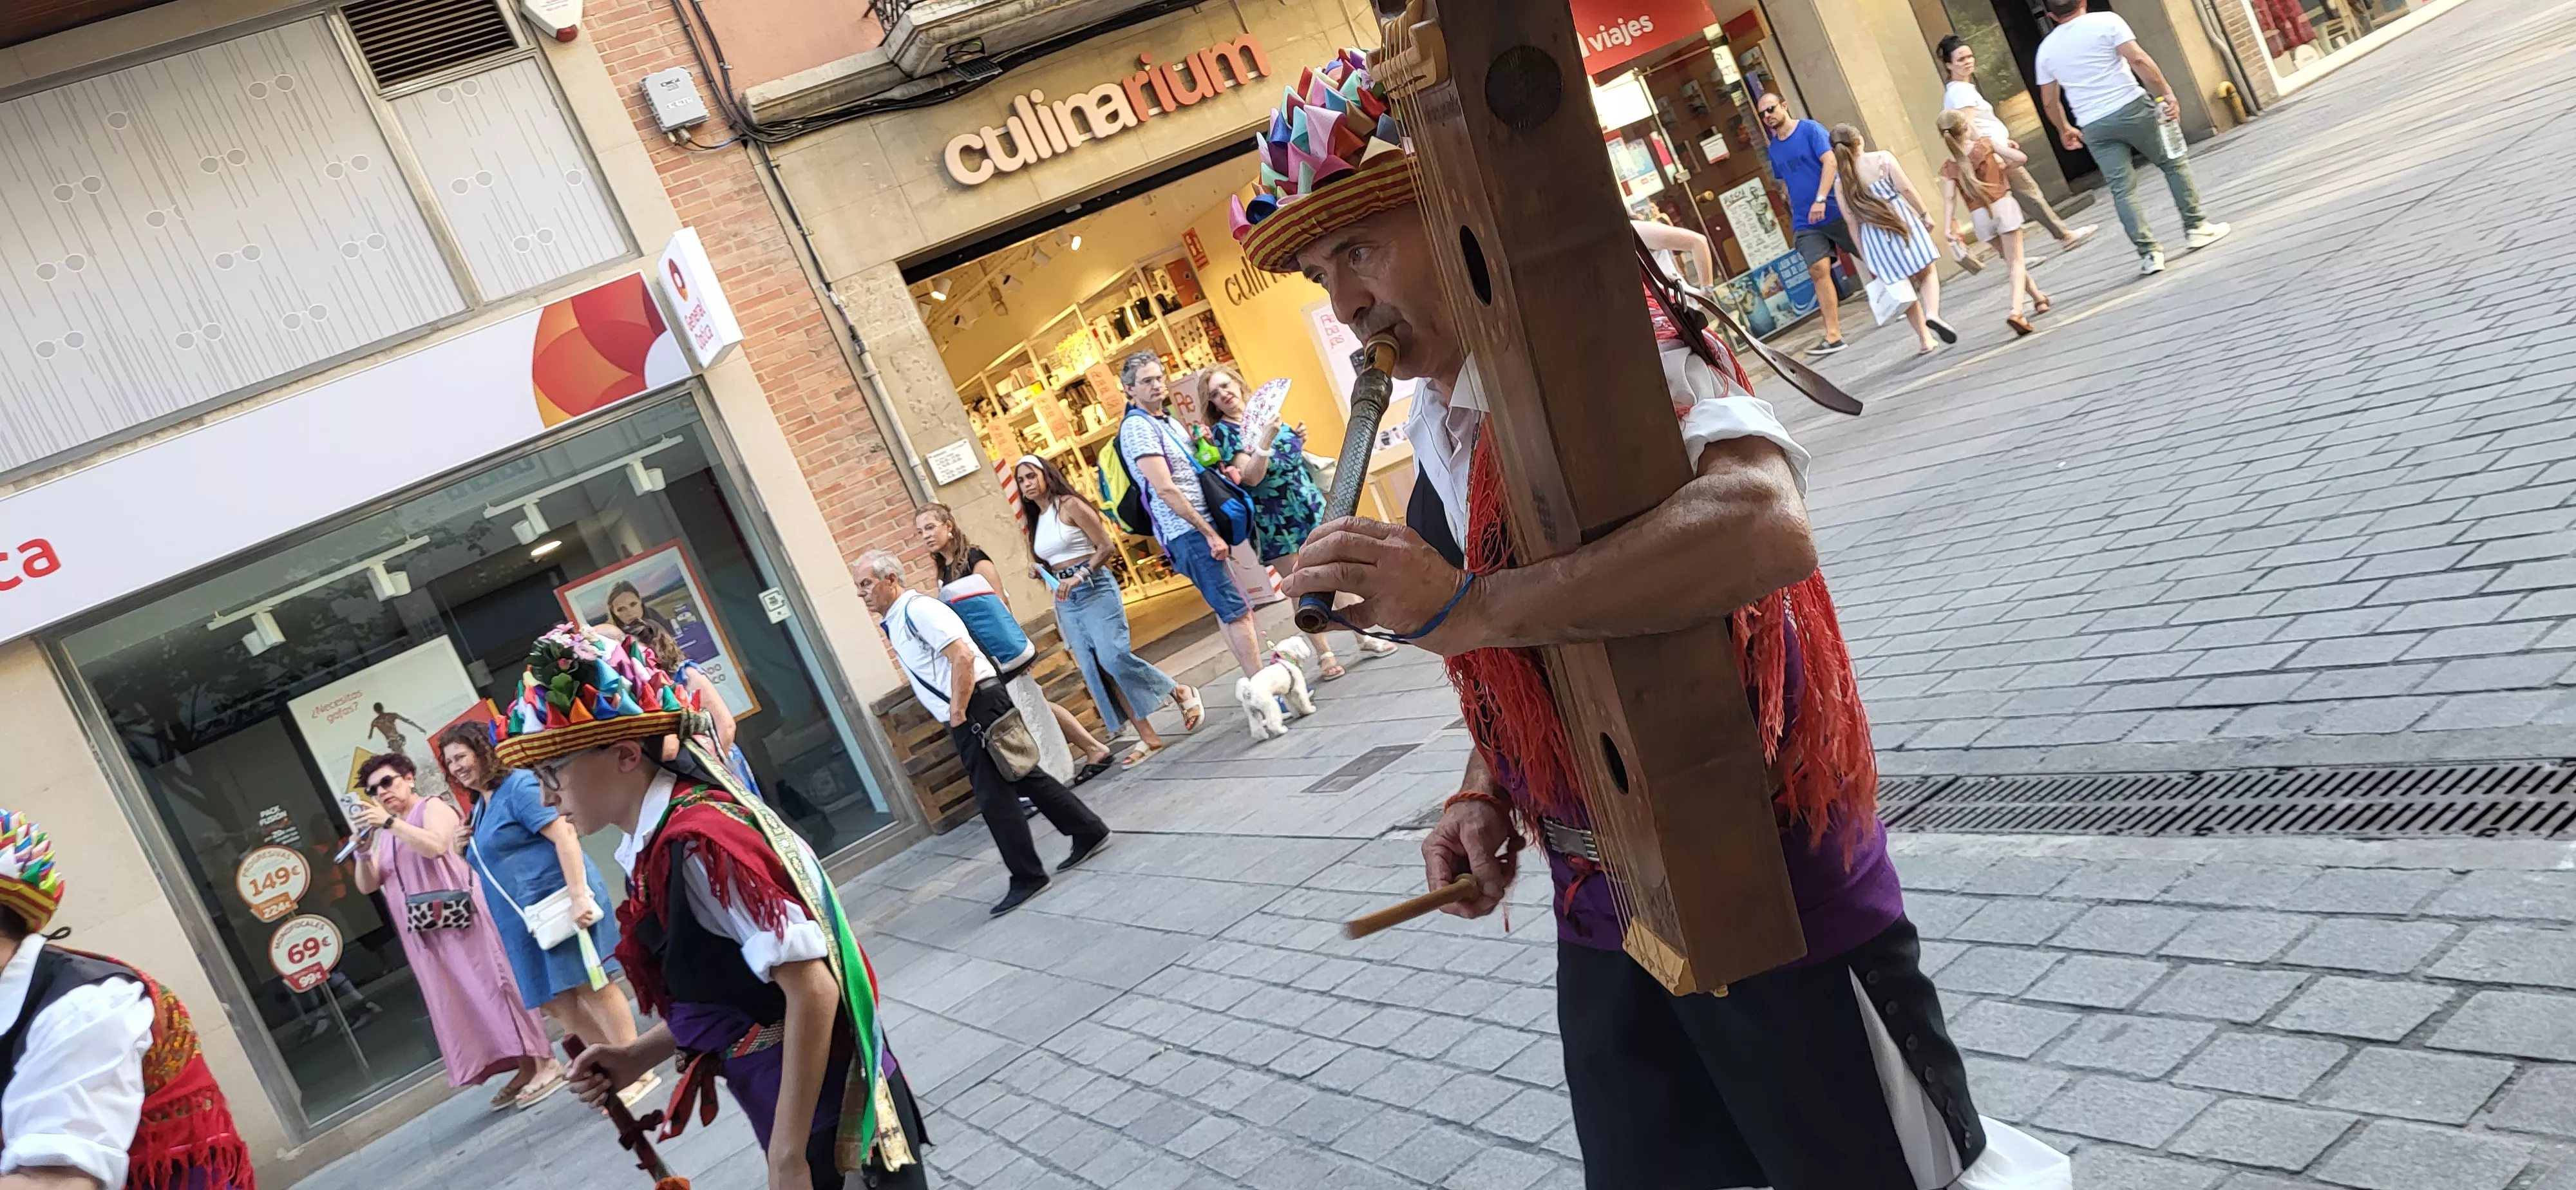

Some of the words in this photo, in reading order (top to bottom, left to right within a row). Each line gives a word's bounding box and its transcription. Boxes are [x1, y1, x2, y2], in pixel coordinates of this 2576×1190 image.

[1587, 15, 1654, 52] viajes
[944, 33, 1272, 186] culinarium
[312, 690, 363, 719] ¿Necesitas
[327, 701, 359, 724] gafas?
